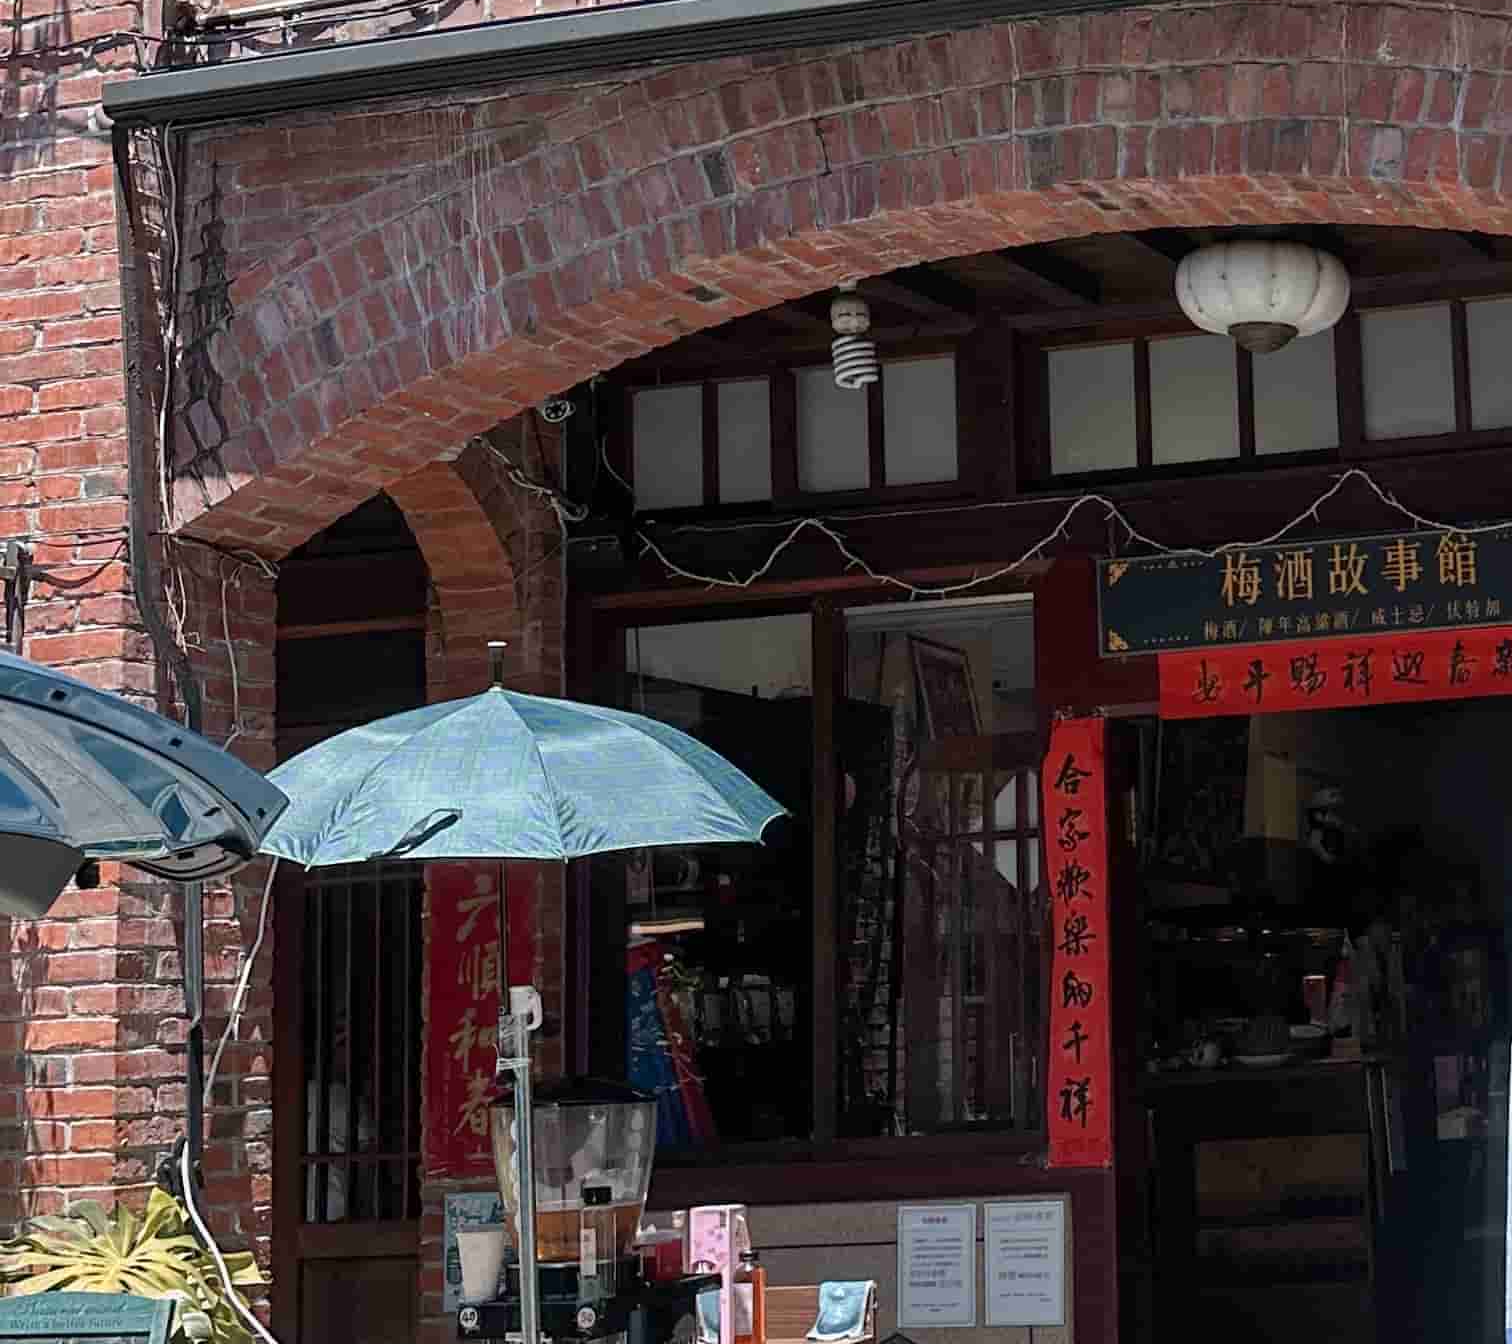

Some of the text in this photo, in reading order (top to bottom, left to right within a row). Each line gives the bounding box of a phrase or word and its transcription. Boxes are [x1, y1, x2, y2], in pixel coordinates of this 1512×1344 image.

[1219, 532, 1480, 609] 梅酒故事館
